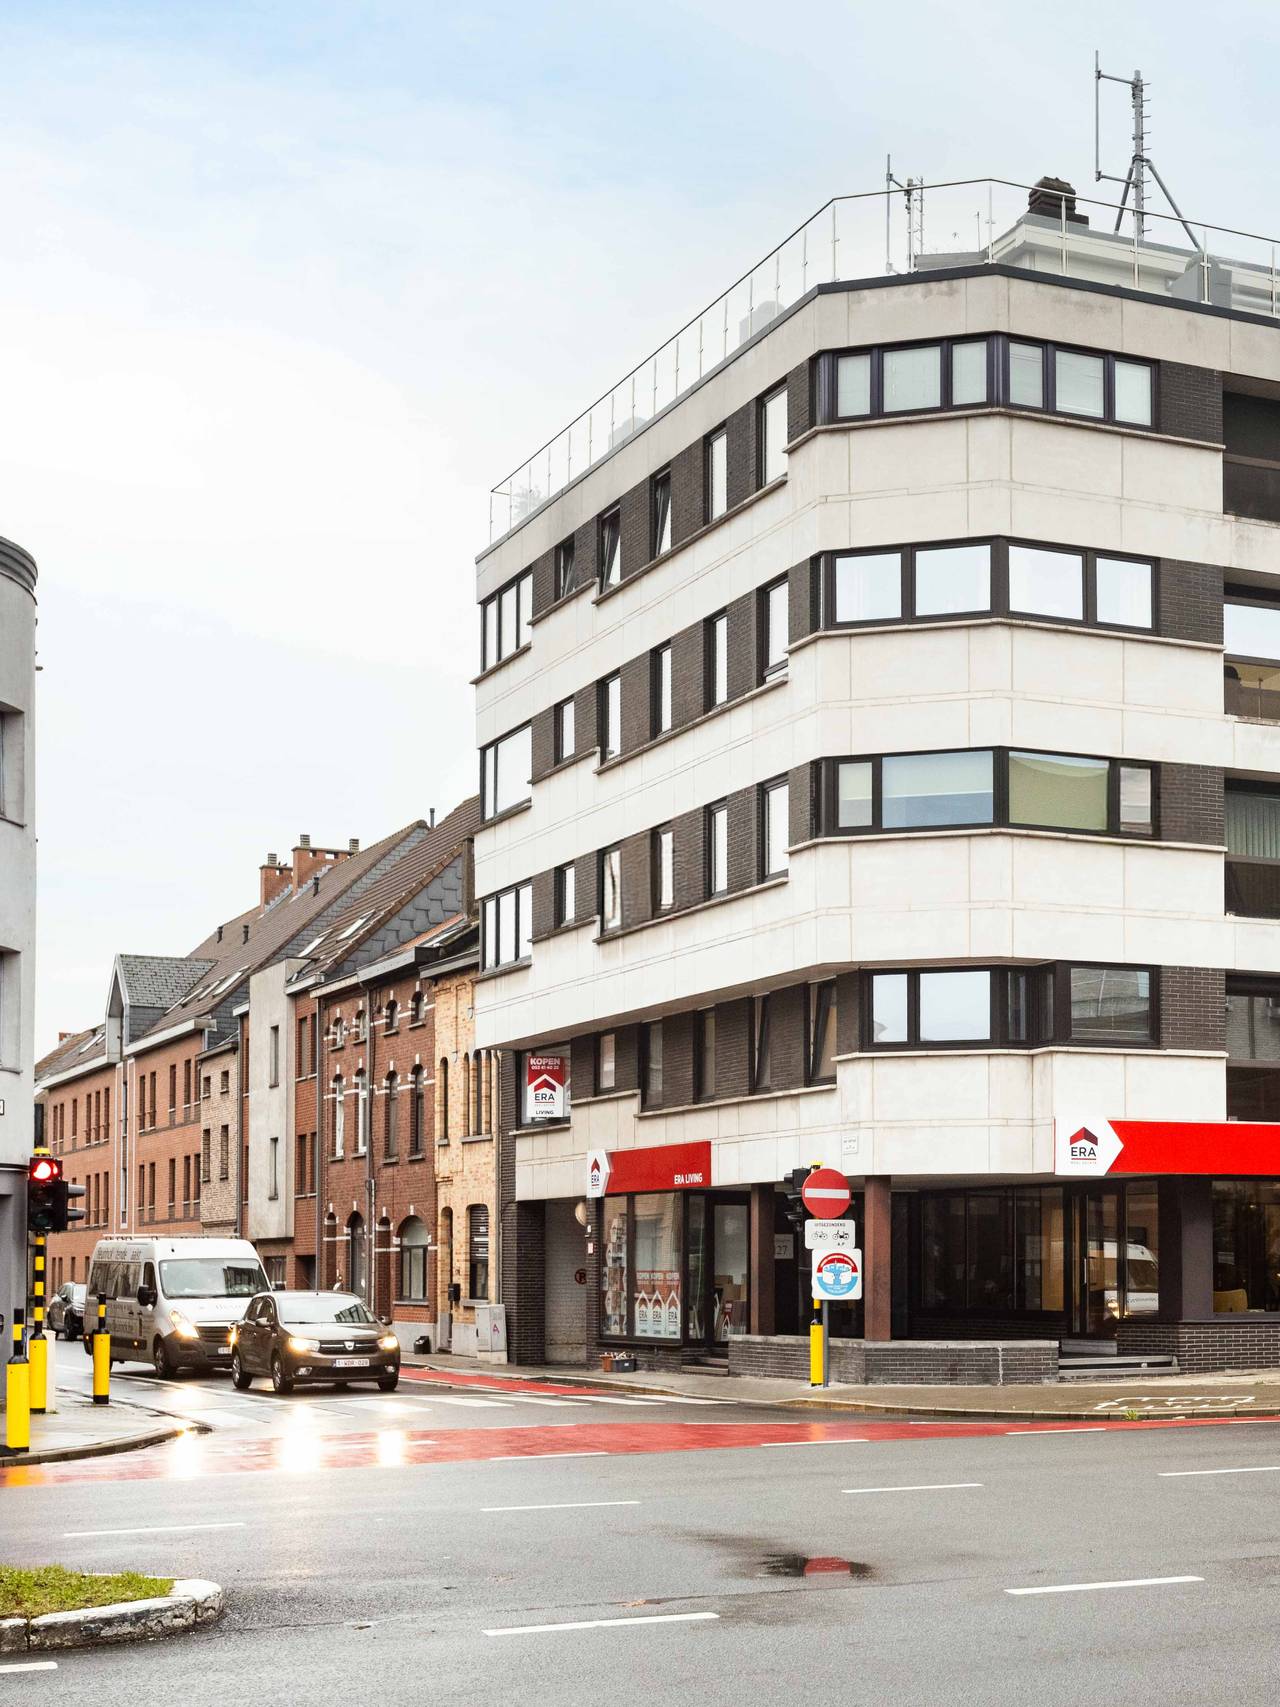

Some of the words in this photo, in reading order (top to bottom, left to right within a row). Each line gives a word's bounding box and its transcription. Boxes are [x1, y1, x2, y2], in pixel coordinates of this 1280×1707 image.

[530, 1057, 561, 1065] KOPEN
[534, 1093, 555, 1101] ERA
[1071, 1146, 1097, 1157] ERA
[591, 1174, 600, 1184] ERA
[674, 1174, 685, 1184] ERA
[686, 1173, 703, 1184] LIVING
